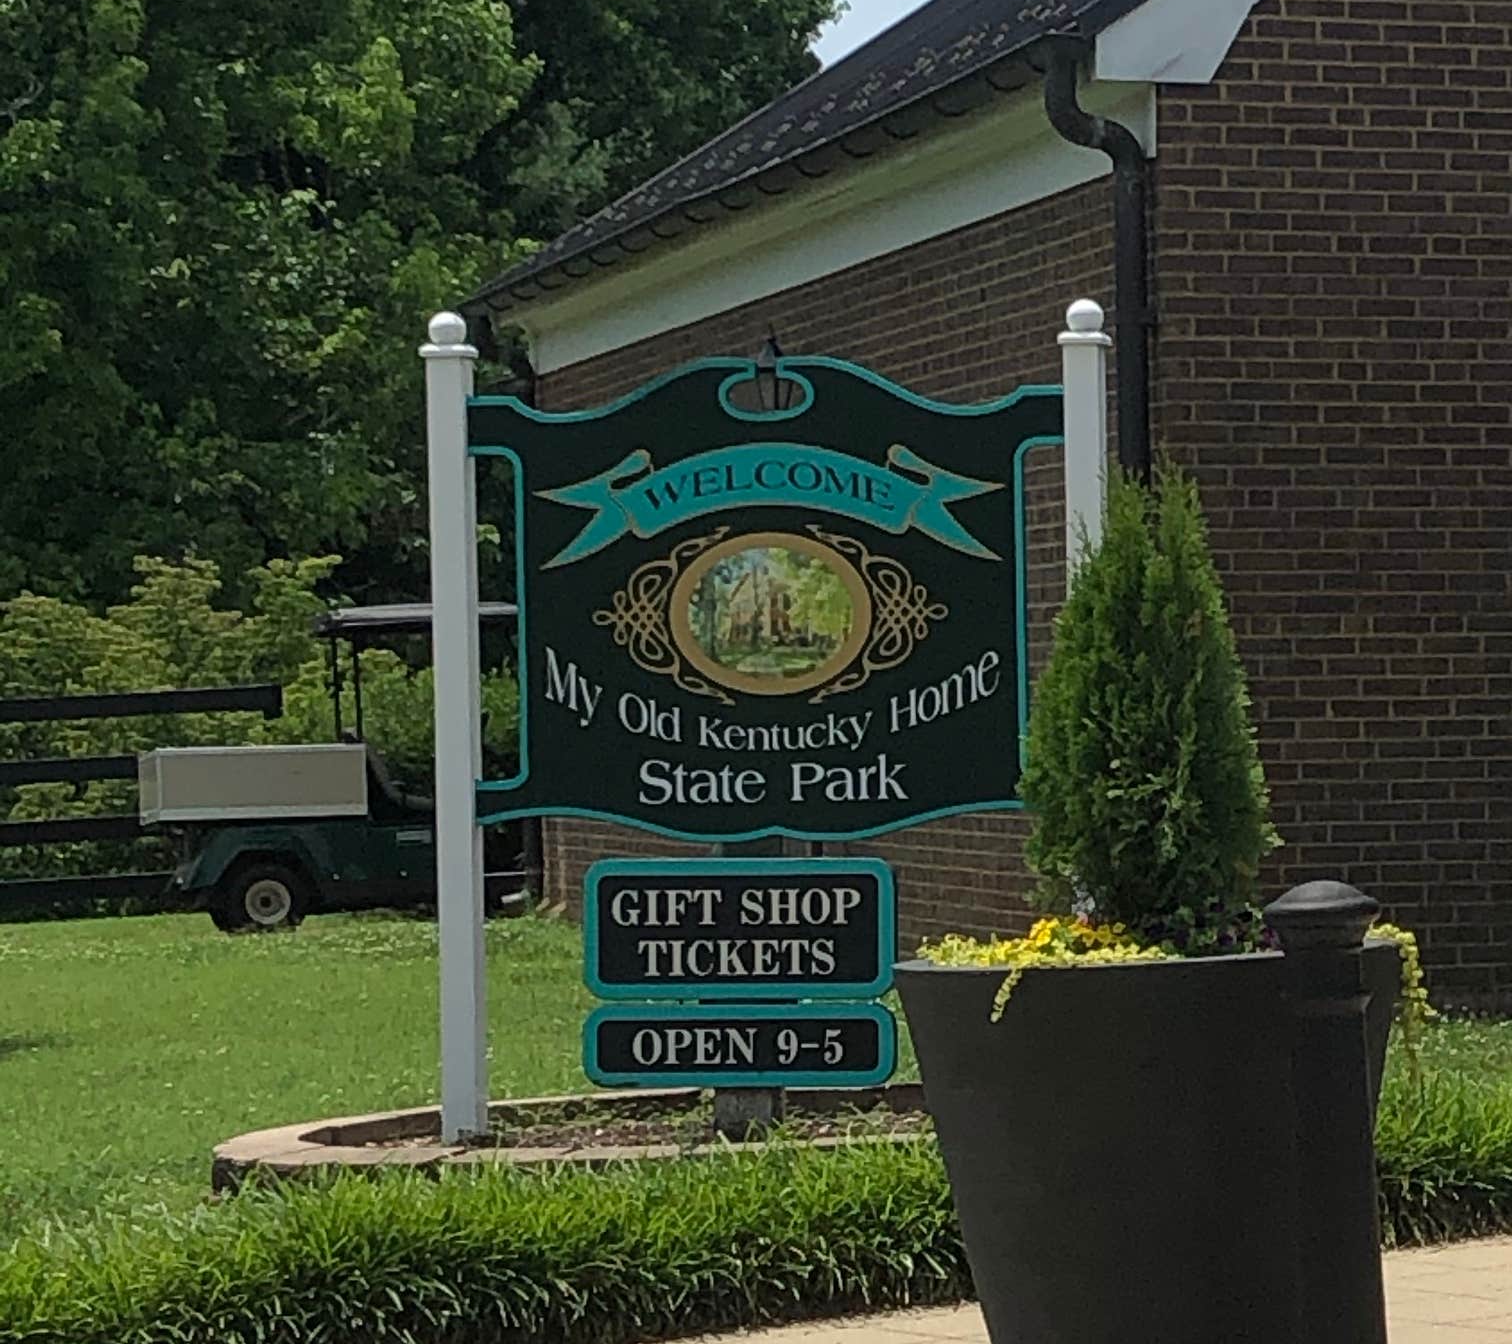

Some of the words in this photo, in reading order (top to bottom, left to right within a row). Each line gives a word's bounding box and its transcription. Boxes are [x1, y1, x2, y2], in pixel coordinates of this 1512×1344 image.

[645, 460, 895, 511] WELCOME
[544, 646, 602, 727] My
[618, 692, 682, 743] Old
[699, 711, 873, 752] Kentucky
[890, 650, 1000, 733] Home
[638, 759, 766, 806] State
[790, 753, 909, 803] Park
[611, 888, 722, 926] GIFT
[740, 887, 861, 925] SHOP
[638, 939, 836, 977] TICKETS
[632, 1028, 758, 1065] OPEN
[776, 1028, 844, 1065] 9-5
